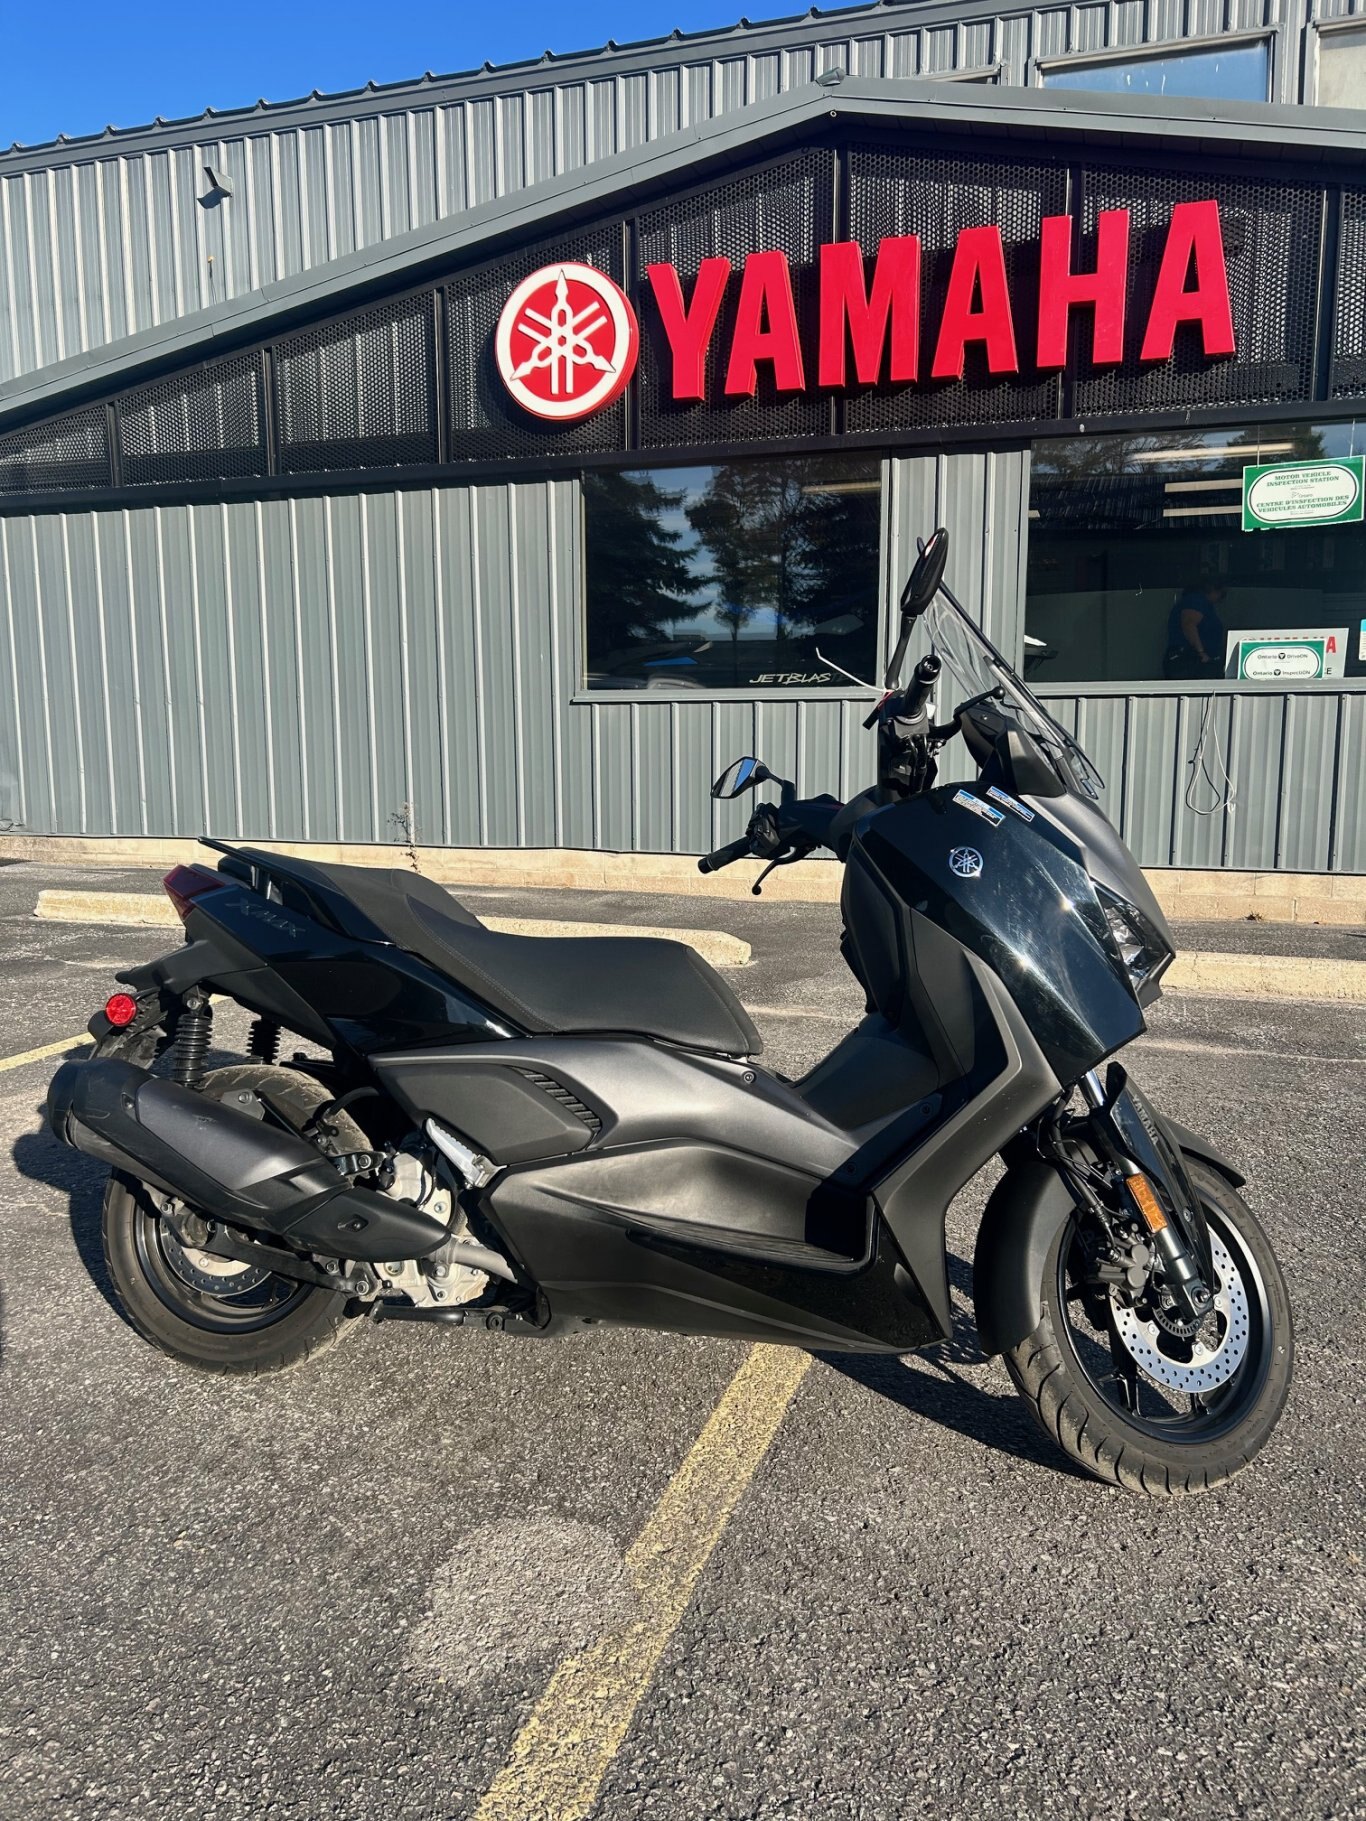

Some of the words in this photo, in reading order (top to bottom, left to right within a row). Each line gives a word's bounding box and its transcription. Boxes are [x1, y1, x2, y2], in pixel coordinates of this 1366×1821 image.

[647, 200, 1235, 400] YAMAHA
[1302, 471, 1332, 479] VEHICLE
[1266, 479, 1308, 487] INSPECTION
[1310, 475, 1340, 483] STATION
[1285, 497, 1334, 505] D'INSPECTION
[1297, 501, 1348, 510] AUTOMOBILES
[1132, 1094, 1159, 1146] YAMAHA
